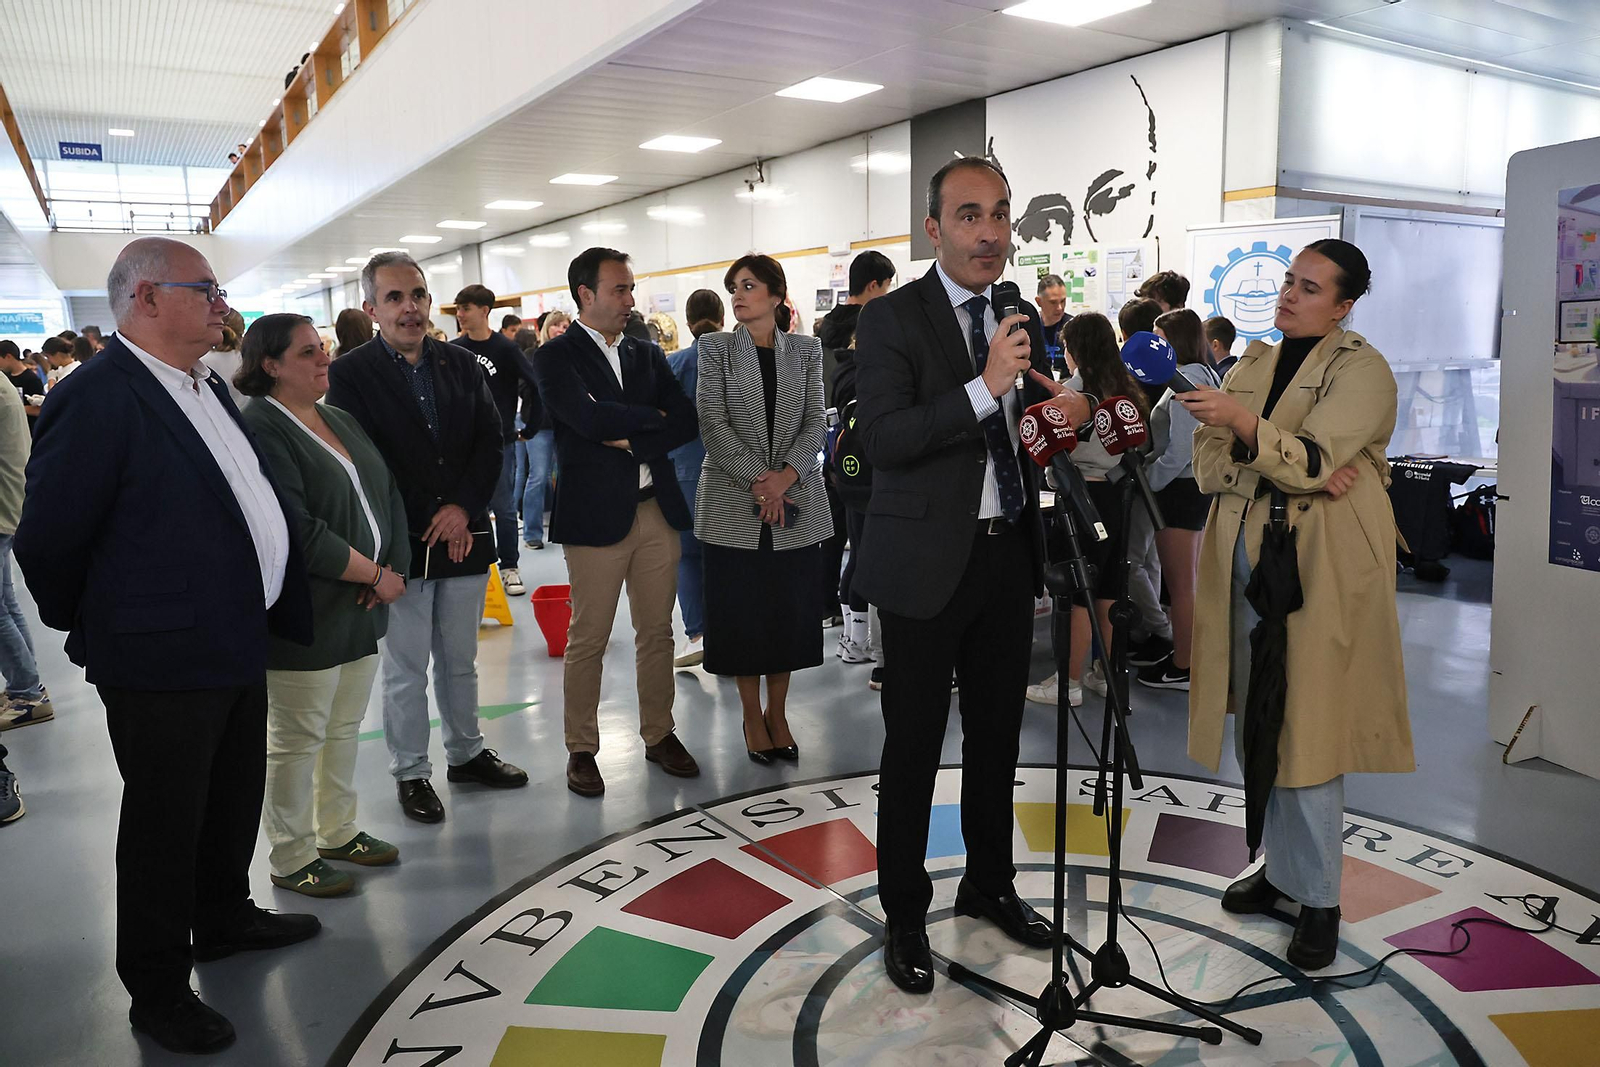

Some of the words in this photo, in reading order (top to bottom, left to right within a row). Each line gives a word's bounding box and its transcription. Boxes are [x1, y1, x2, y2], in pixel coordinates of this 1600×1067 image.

[62, 147, 99, 156] SUBIDA
[475, 354, 497, 376] IGER
[1078, 777, 1475, 879] SAPRE
